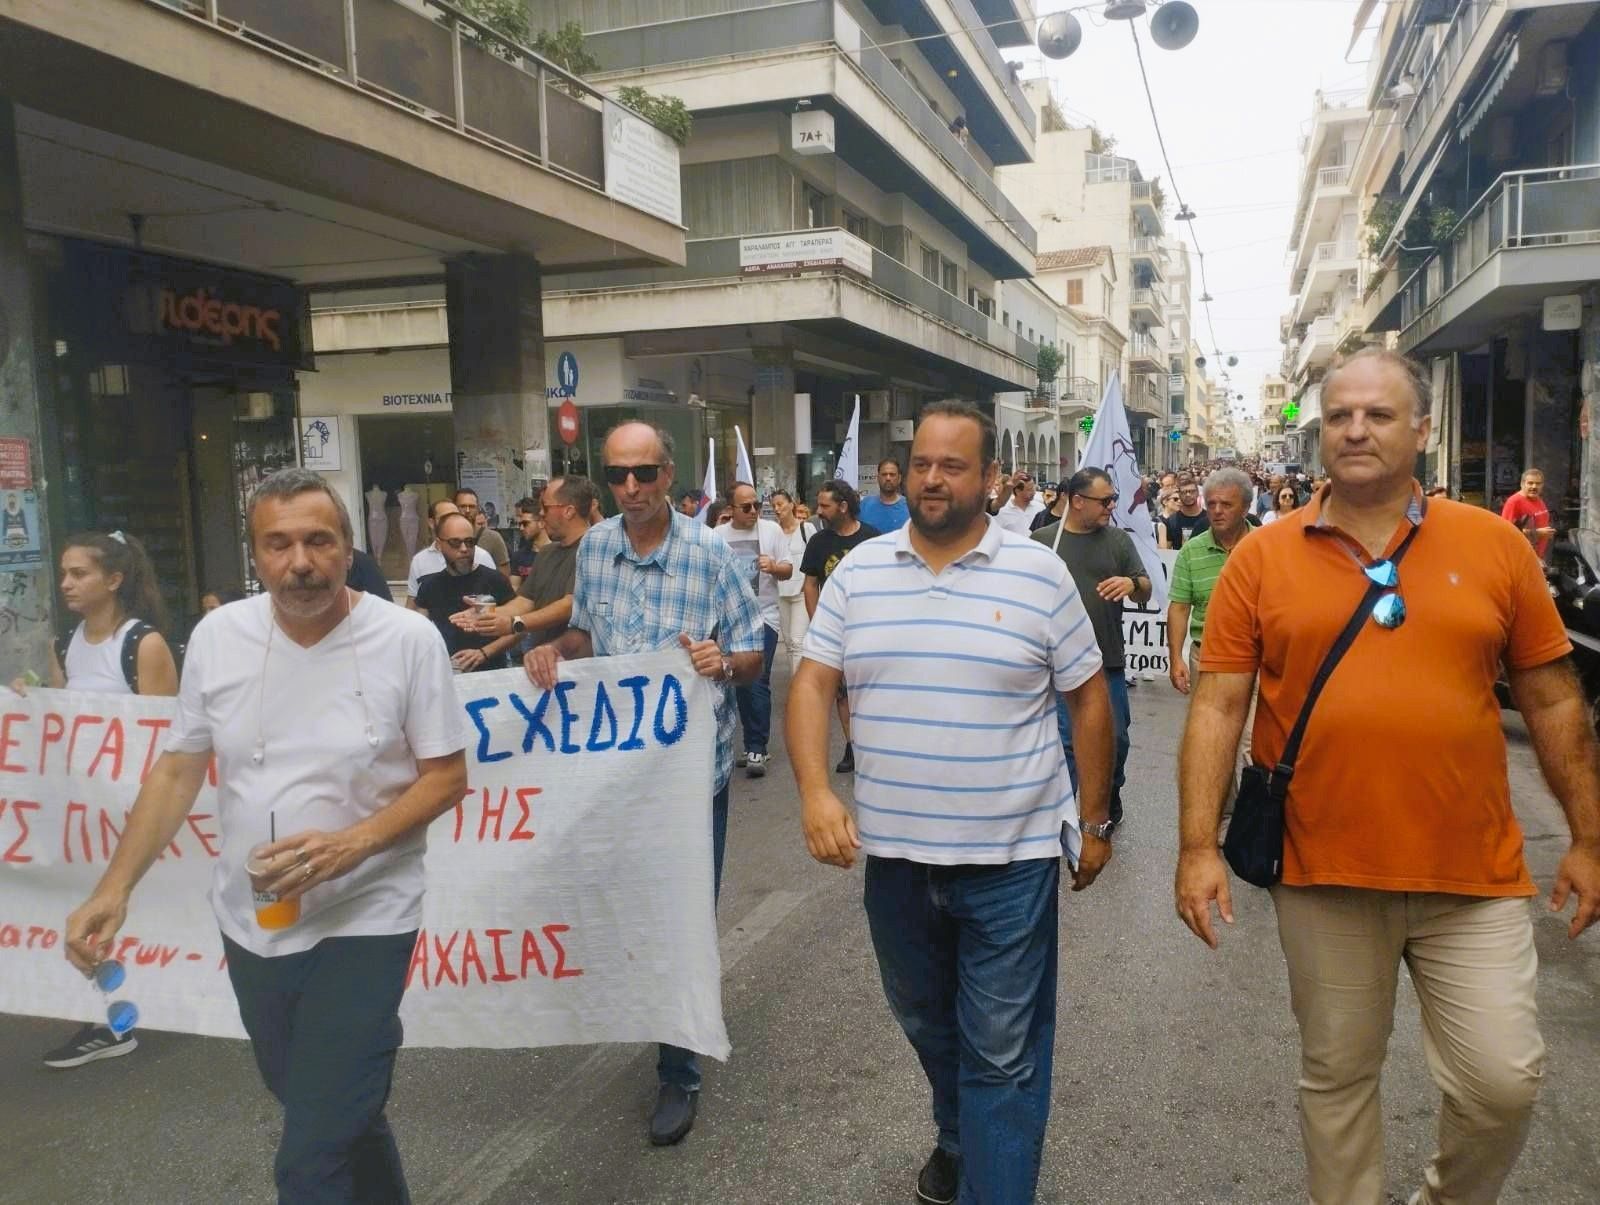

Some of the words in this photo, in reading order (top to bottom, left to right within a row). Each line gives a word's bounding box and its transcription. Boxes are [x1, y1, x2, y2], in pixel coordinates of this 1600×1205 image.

[383, 393, 442, 406] ΒΙΟΤΕΧΝΙΑ
[1124, 653, 1168, 673] τρας
[465, 674, 688, 763] ΣΧΕΔΙΟ
[405, 924, 584, 990] ΑΧΑΙΑΣ
